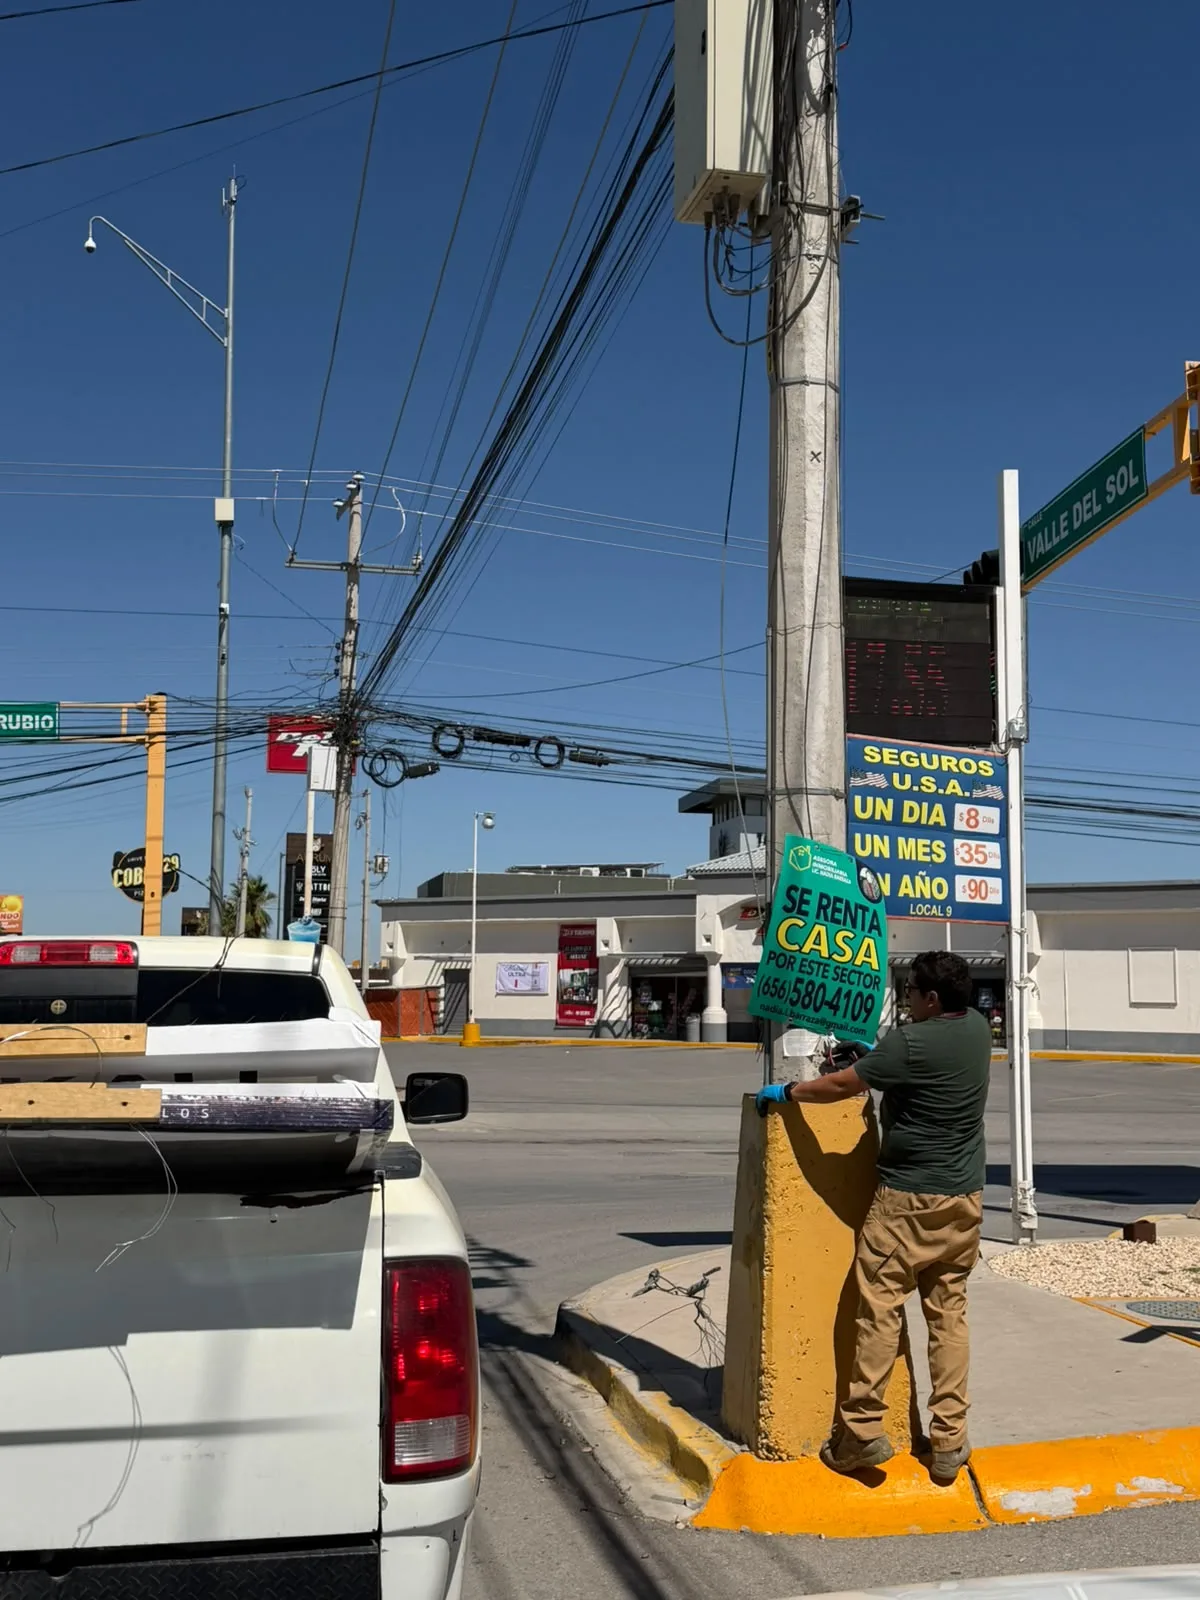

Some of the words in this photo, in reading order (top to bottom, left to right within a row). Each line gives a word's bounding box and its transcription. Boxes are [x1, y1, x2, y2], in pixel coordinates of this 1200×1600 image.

[1027, 510, 1069, 563] VALLE
[1072, 488, 1102, 531] DEL
[1106, 458, 1139, 504] SOL
[0, 714, 54, 732] RUBIO
[864, 745, 995, 776] SEGUROS
[892, 772, 970, 797] U.S.A.
[854, 795, 894, 821] UN
[902, 800, 947, 826] DIA
[854, 832, 890, 858] UN
[897, 836, 947, 864] MES
[113, 866, 144, 888] COB
[876, 872, 891, 896] N
[898, 870, 948, 900] AÑO
[782, 884, 812, 917] SE
[816, 892, 882, 937] RENTA
[910, 904, 944, 916] LOCAL
[946, 906, 953, 917] 9
[776, 917, 881, 971] CASA
[766, 951, 796, 972] POR
[798, 958, 830, 979] ESTE
[832, 966, 882, 992] SECTOR
